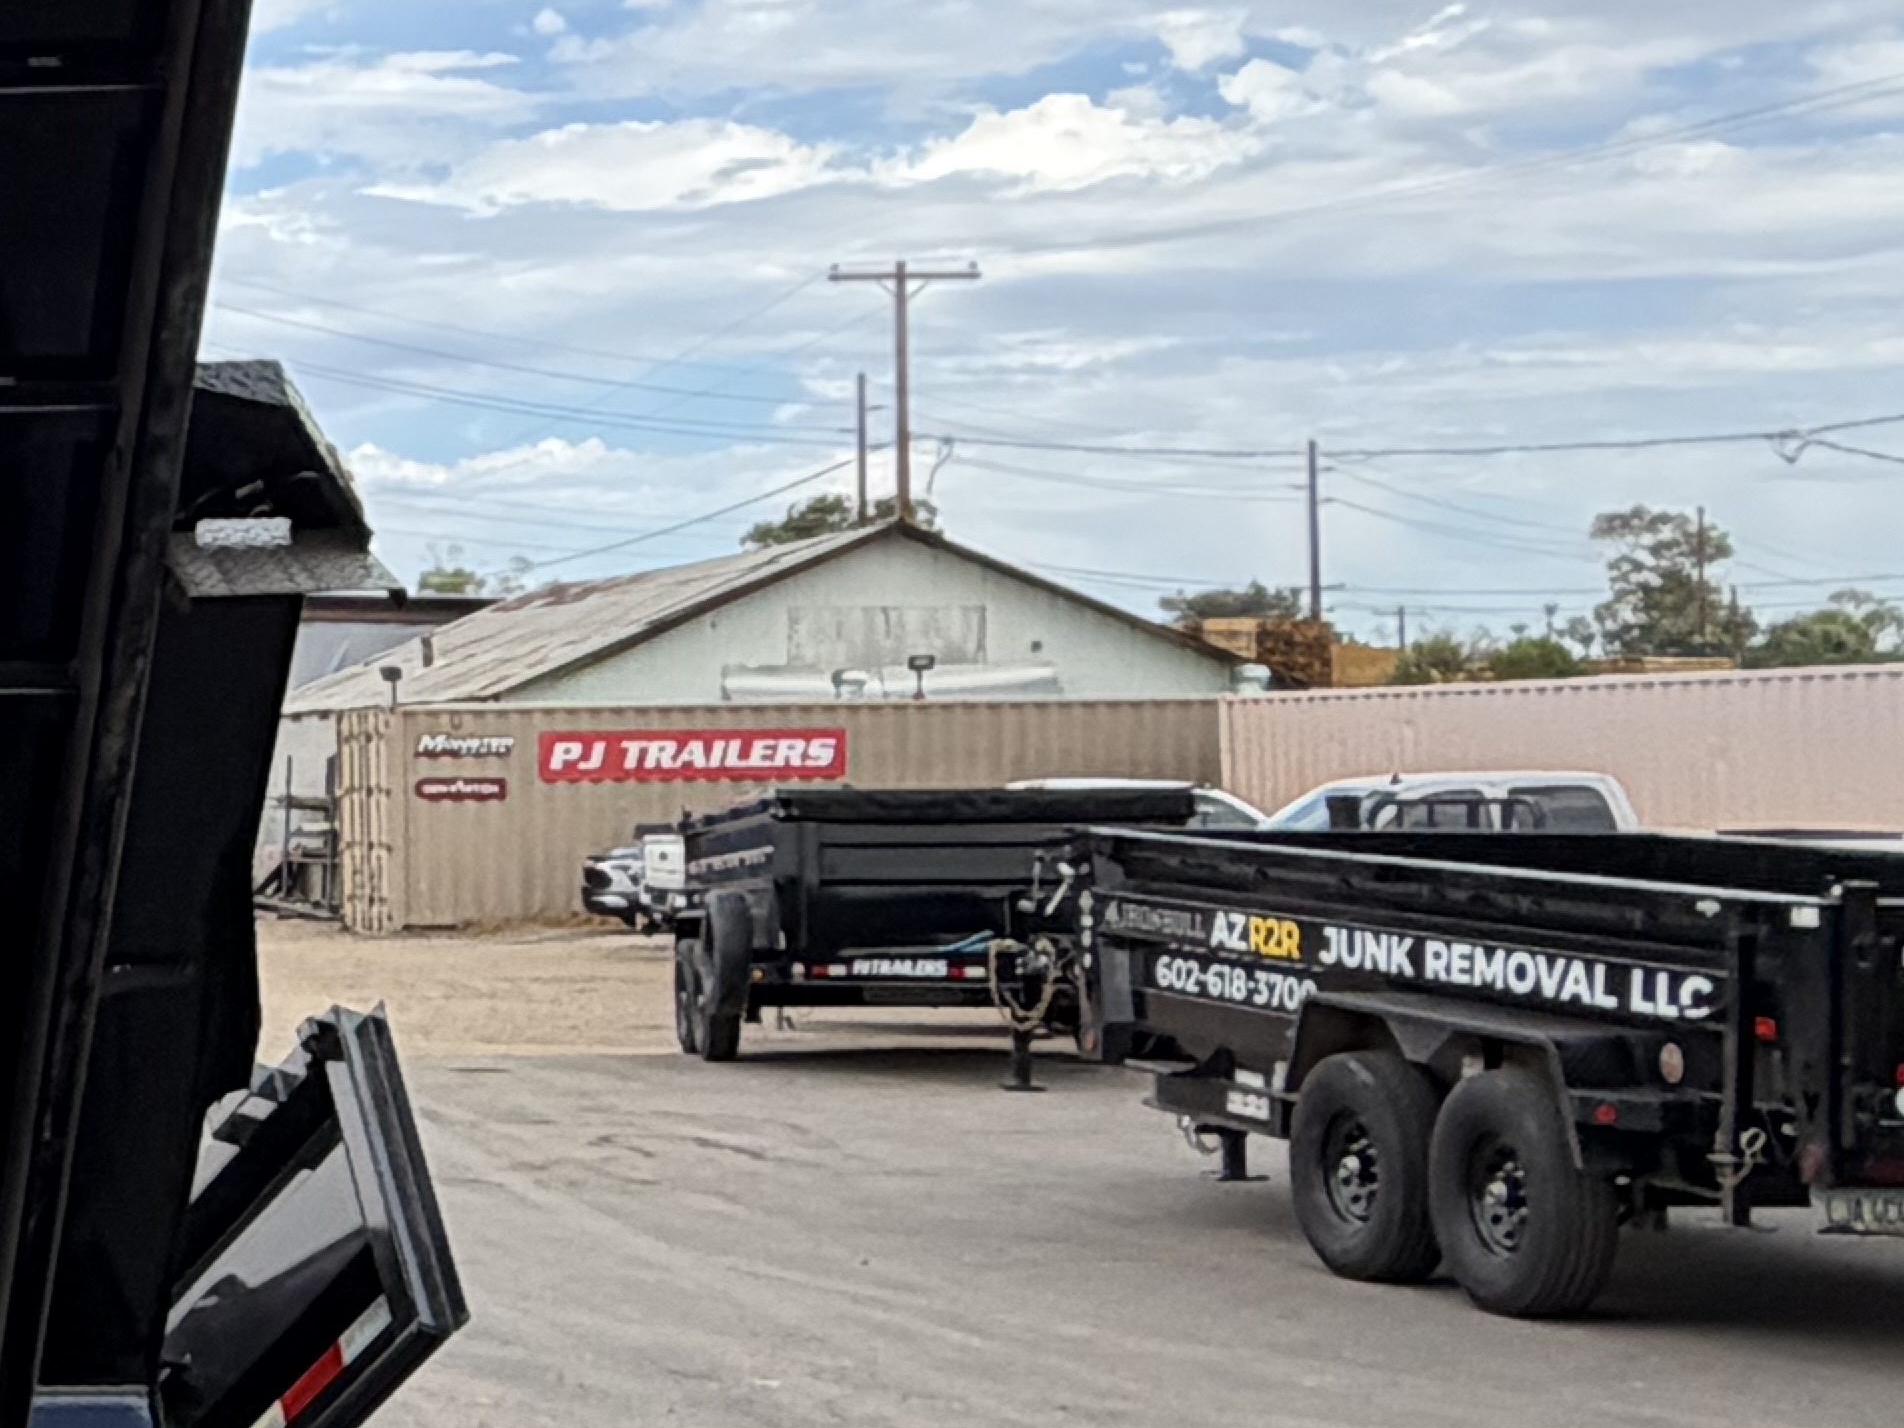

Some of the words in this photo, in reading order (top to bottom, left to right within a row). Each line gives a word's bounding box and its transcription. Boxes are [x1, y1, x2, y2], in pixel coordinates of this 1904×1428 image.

[549, 740, 606, 770] PJ
[620, 737, 837, 770] TRAILERS
[1318, 926, 1415, 977] JUNK
[1424, 939, 1618, 1009] REMOVAL
[1630, 967, 1715, 1020] LLC
